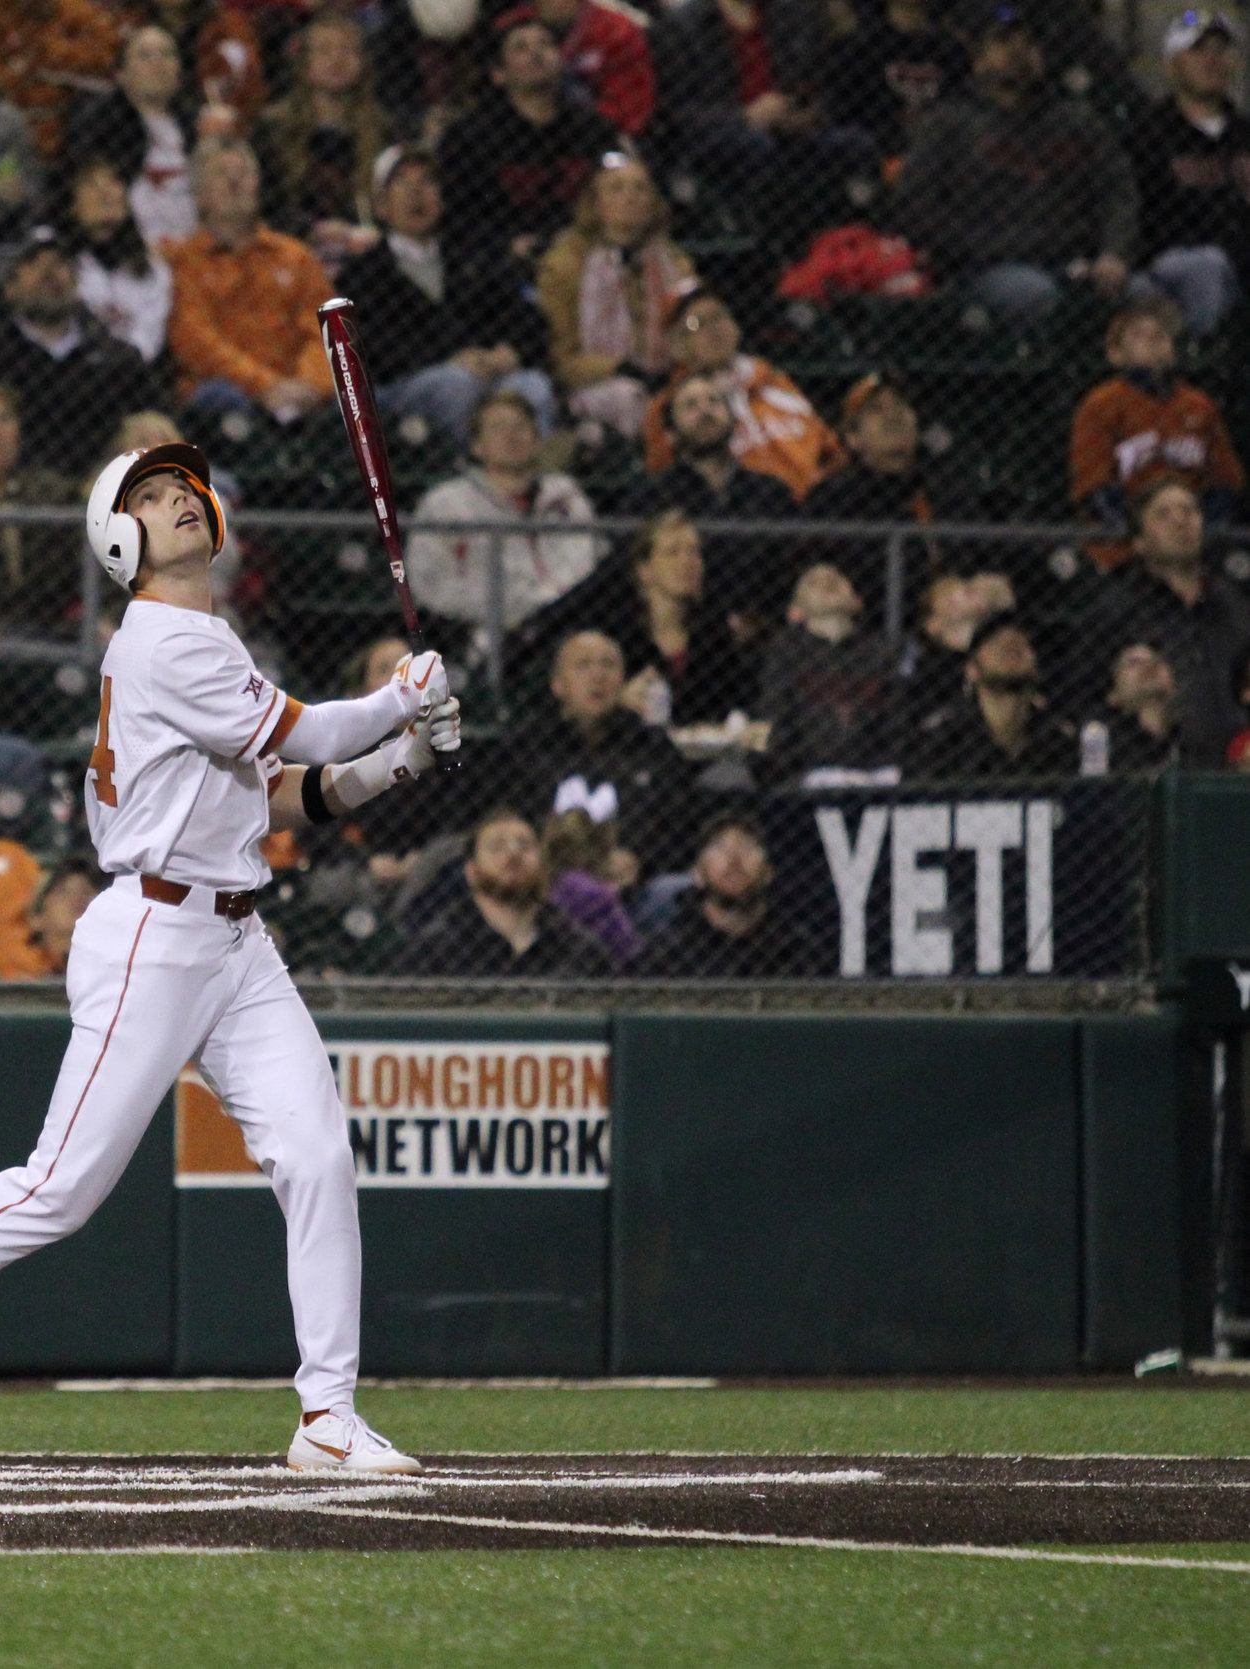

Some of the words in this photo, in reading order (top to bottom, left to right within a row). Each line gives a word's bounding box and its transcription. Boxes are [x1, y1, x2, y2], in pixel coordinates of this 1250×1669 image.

[814, 800, 1054, 977] YETI
[349, 1054, 610, 1109] LONGHORN
[349, 1117, 607, 1175] NETWORK
